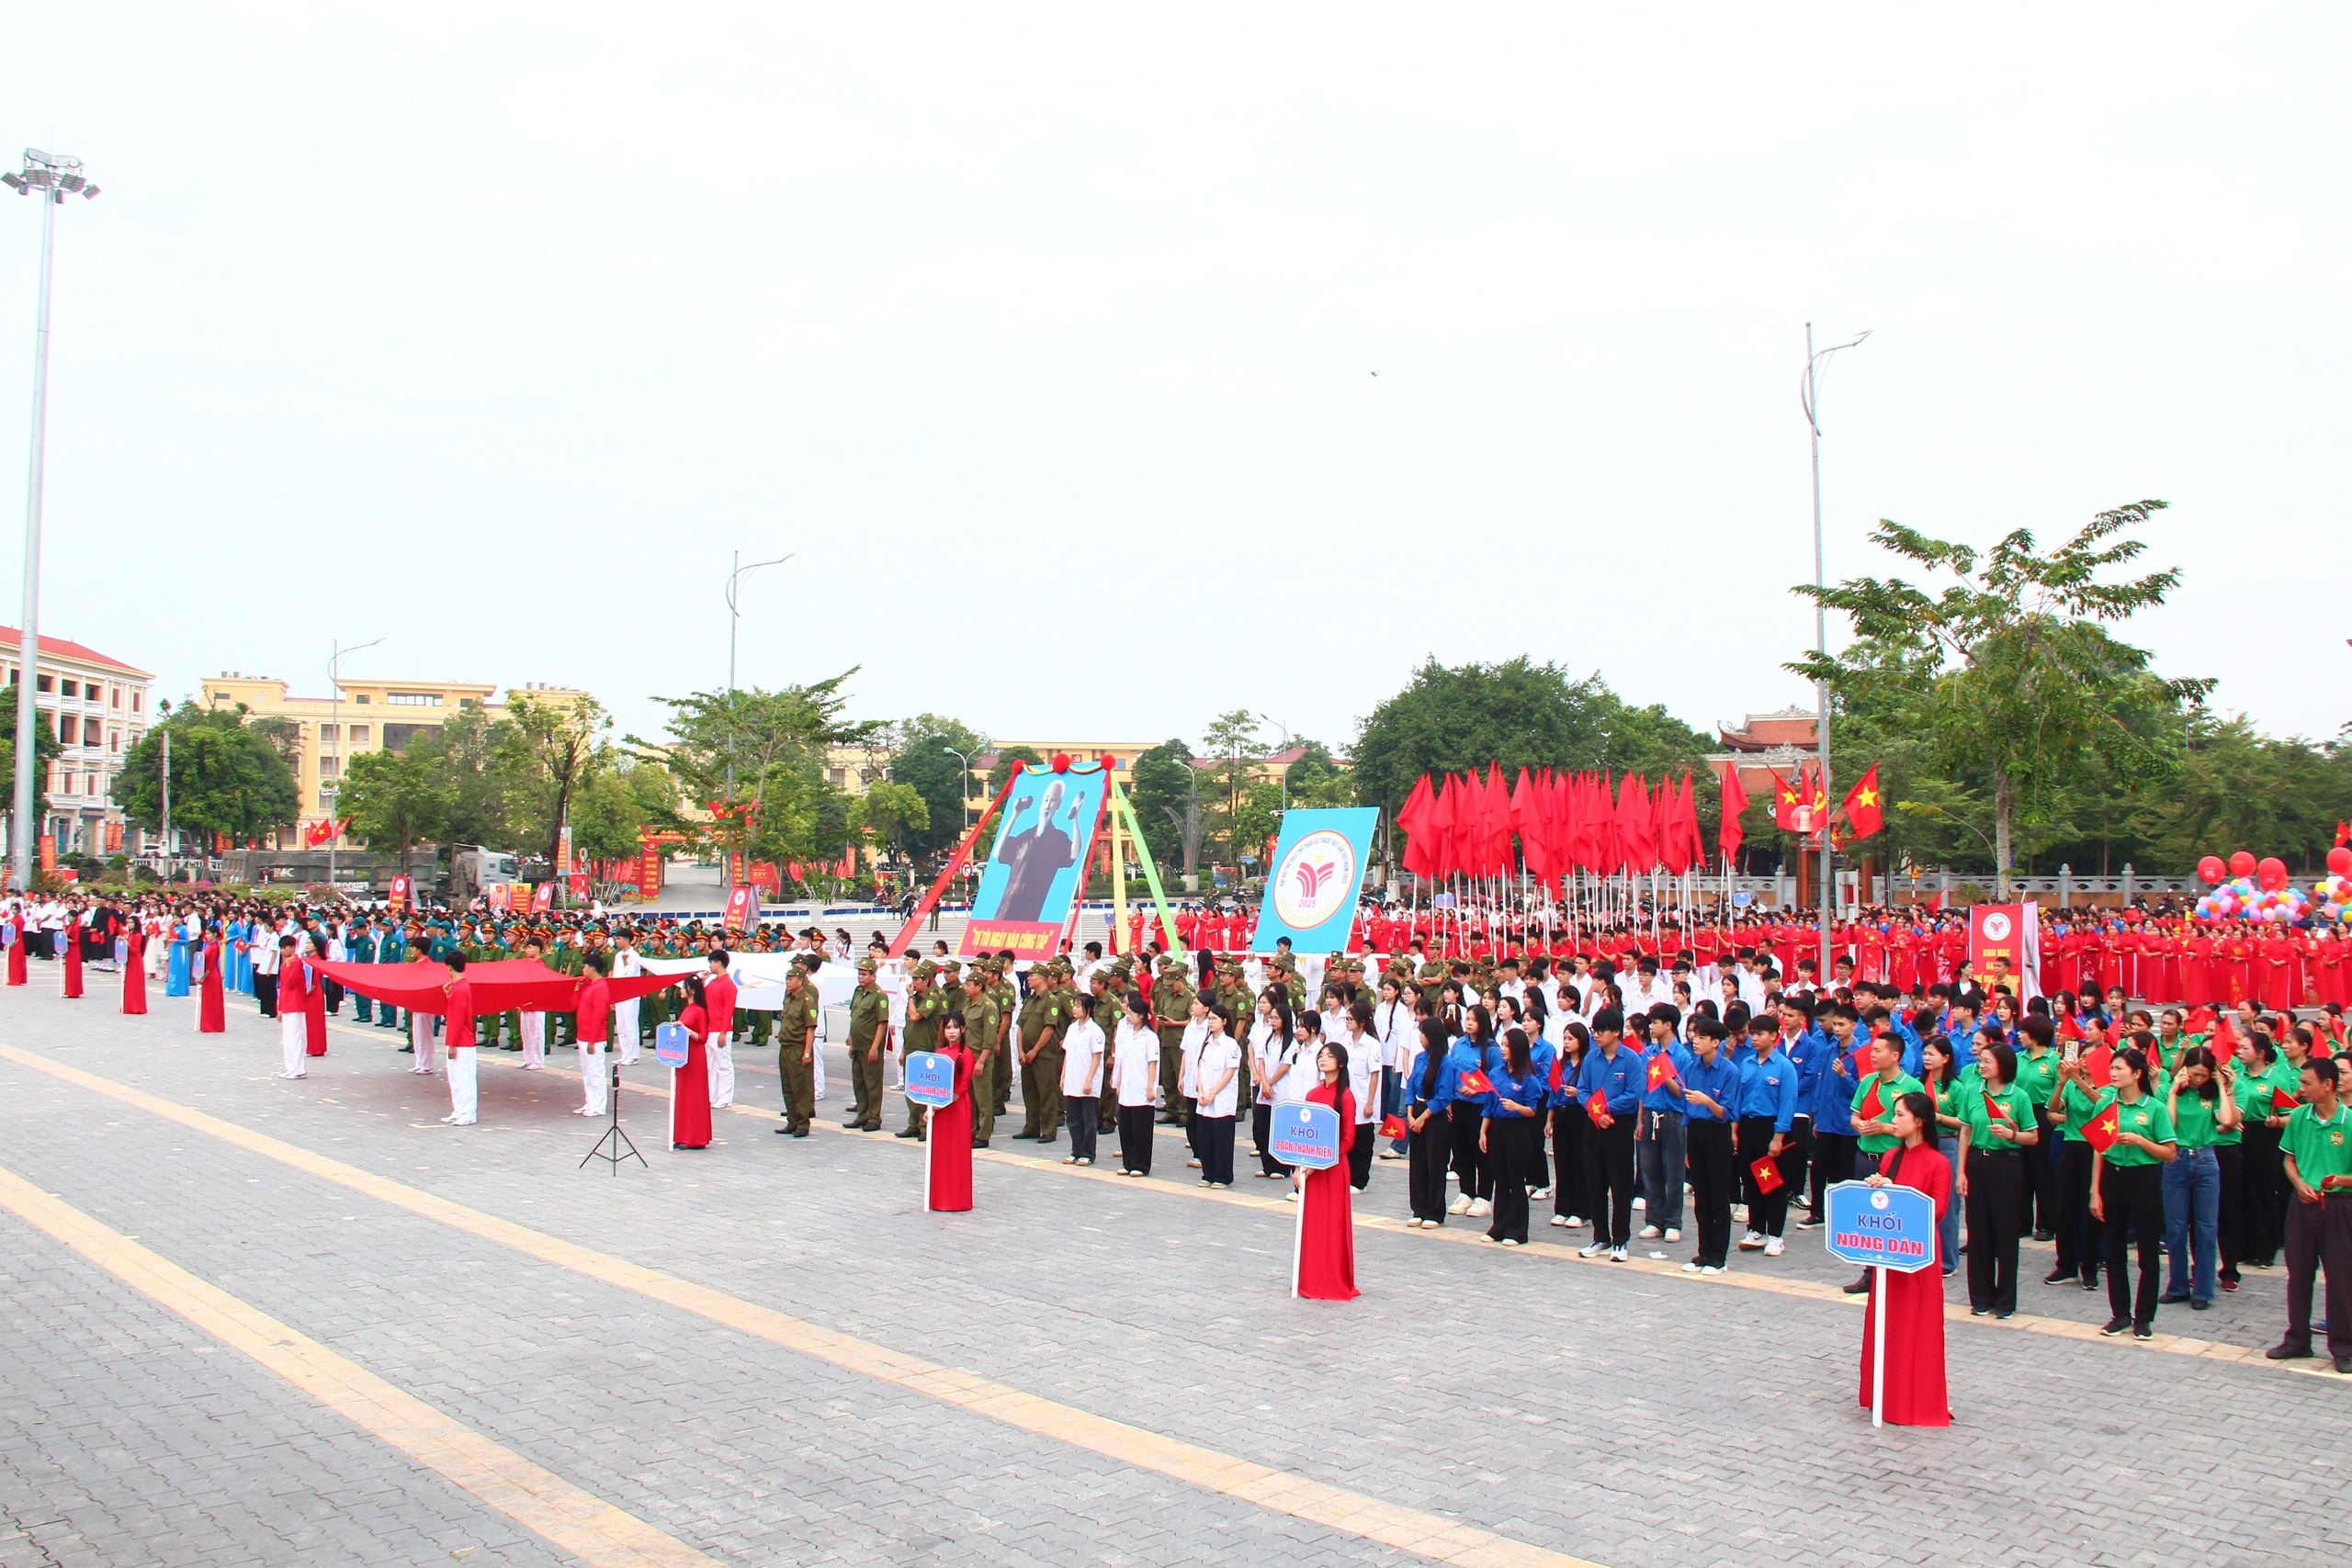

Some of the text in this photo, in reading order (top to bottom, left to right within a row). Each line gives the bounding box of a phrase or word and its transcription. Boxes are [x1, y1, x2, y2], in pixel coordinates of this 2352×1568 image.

[1298, 899, 1317, 908] 2025
[1983, 949, 1996, 957] KHAI
[921, 1071, 940, 1082] KHỐI
[922, 1086, 935, 1095] SINH
[936, 1088, 950, 1098] THPT
[1291, 1124, 1318, 1139] KHỐI
[1295, 1143, 1315, 1156] THANH
[1317, 1145, 1332, 1158] NIÊN
[1858, 1212, 1902, 1231] KHỐI
[1837, 1232, 1924, 1256] NÔNG DÂN
